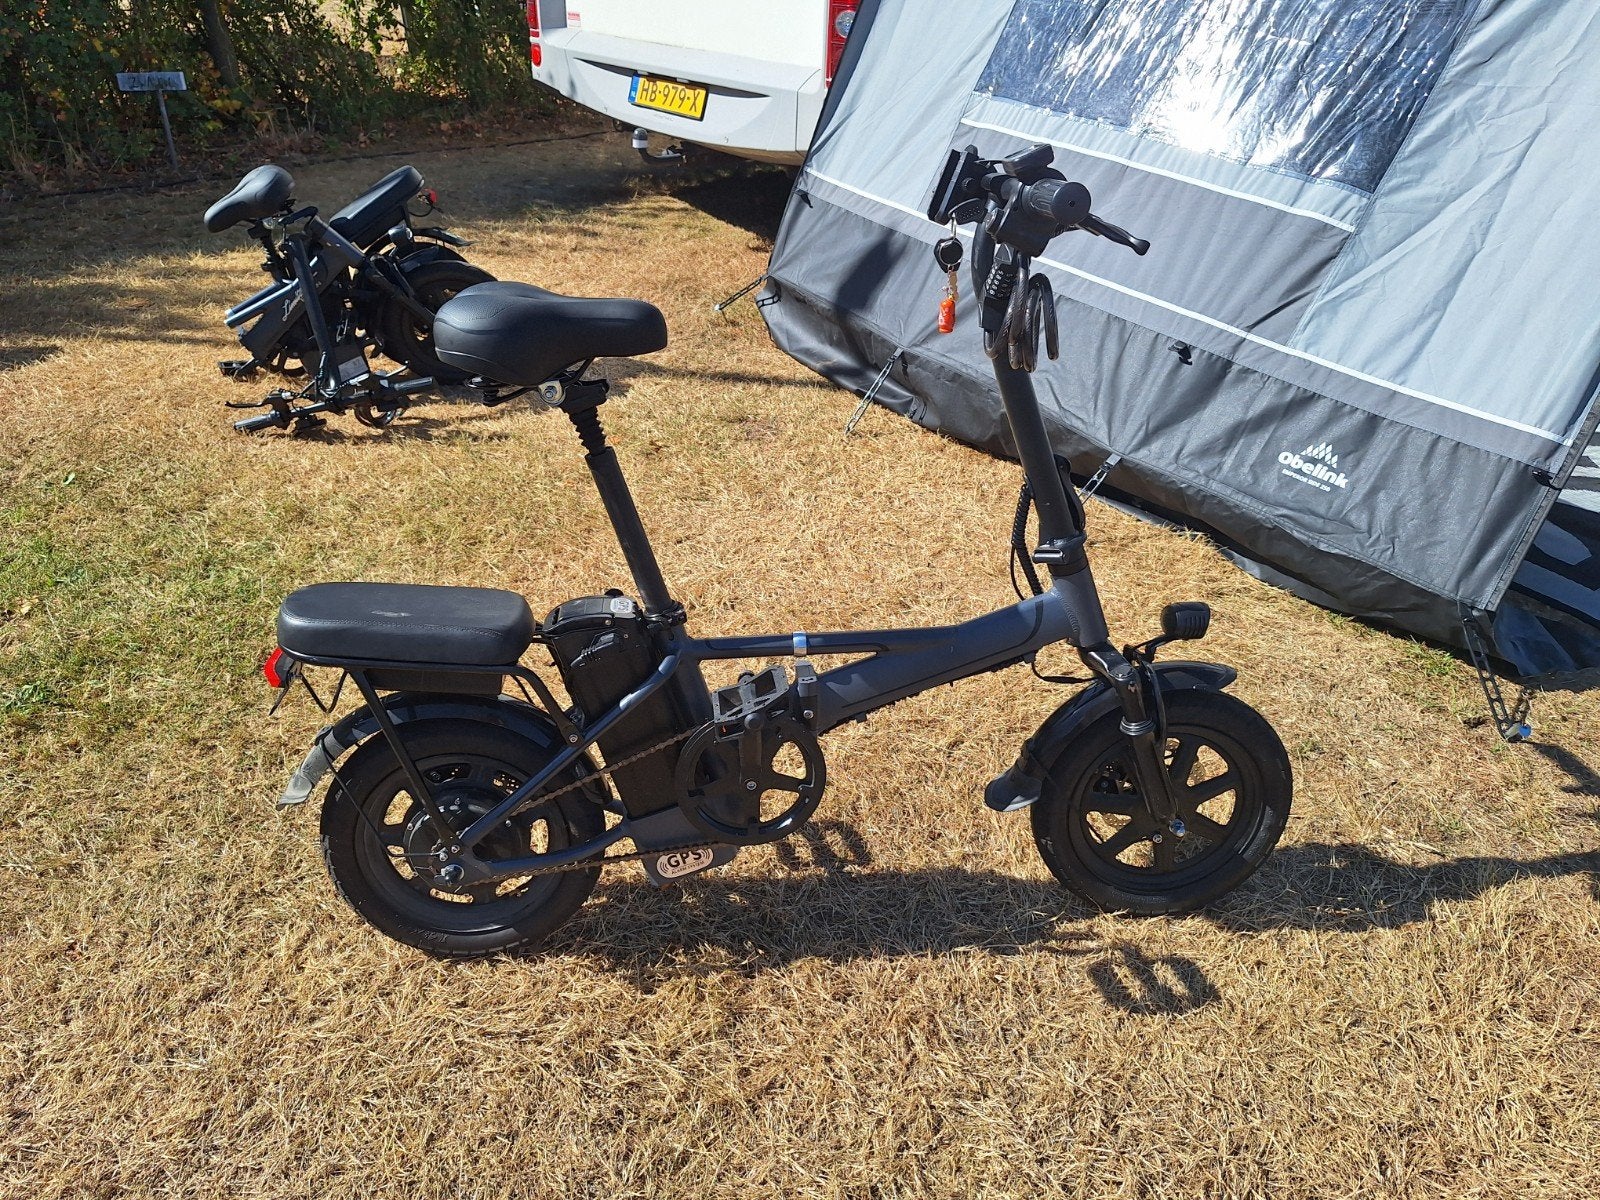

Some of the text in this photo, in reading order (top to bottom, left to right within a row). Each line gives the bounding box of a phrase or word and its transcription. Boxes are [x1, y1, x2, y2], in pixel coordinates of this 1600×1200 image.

[639, 79, 701, 113] HB-979-X
[1278, 451, 1349, 488] Obelink
[668, 850, 702, 867] GPS
